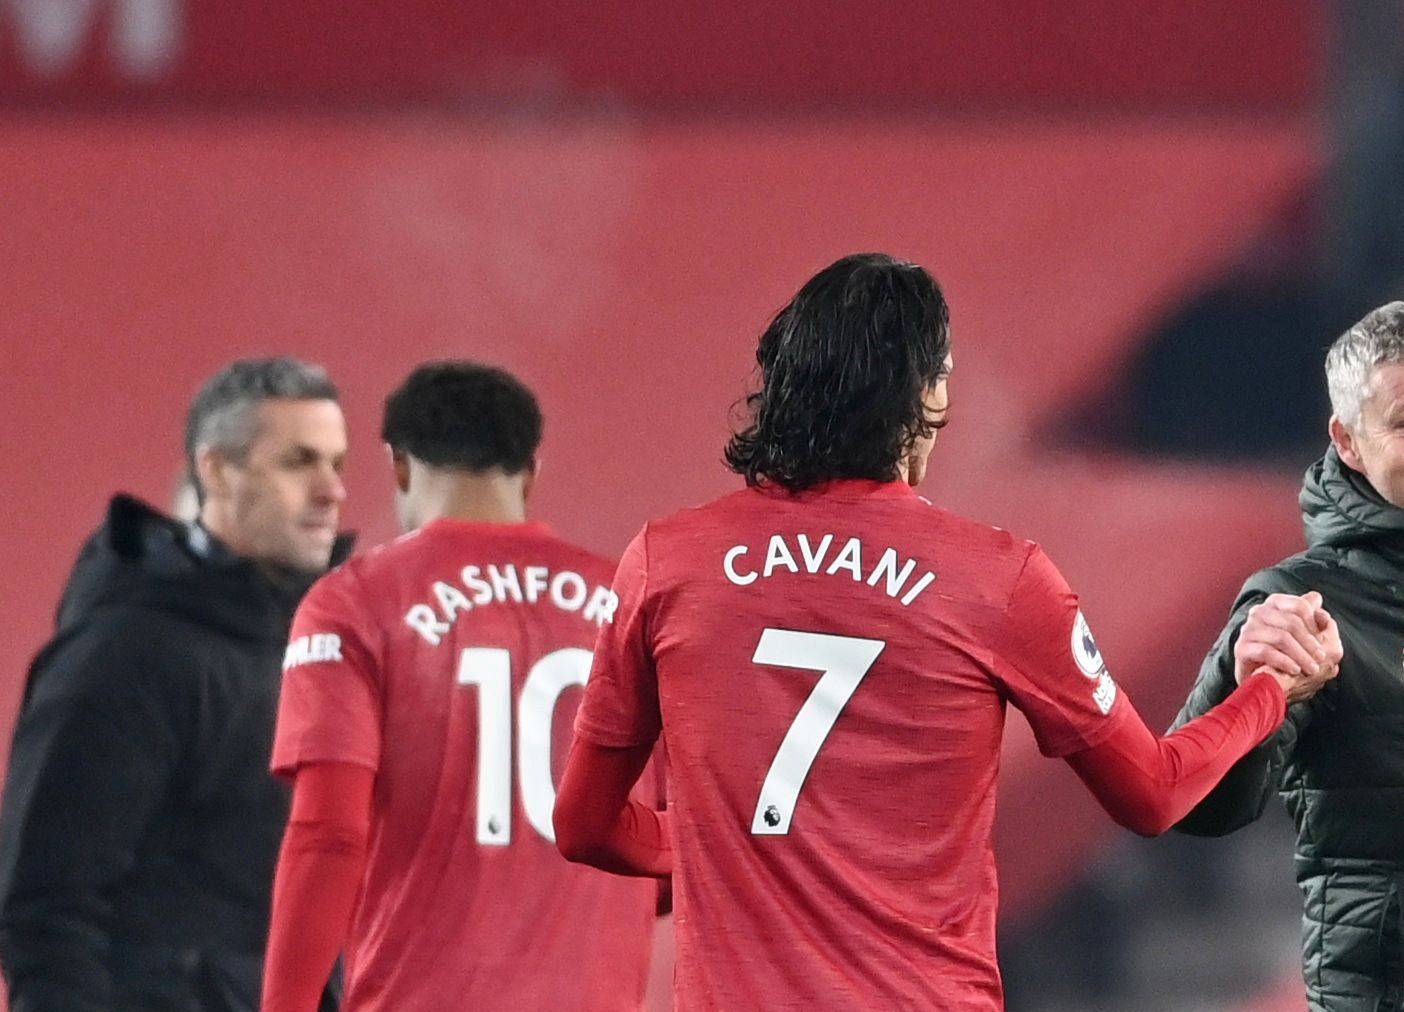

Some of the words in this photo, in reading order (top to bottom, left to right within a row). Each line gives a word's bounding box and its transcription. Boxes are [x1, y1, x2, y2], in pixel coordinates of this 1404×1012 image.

[403, 563, 619, 646] RASHFOR
[723, 533, 936, 606] CAVANI
[457, 647, 595, 846] 10
[751, 627, 887, 835] 7
